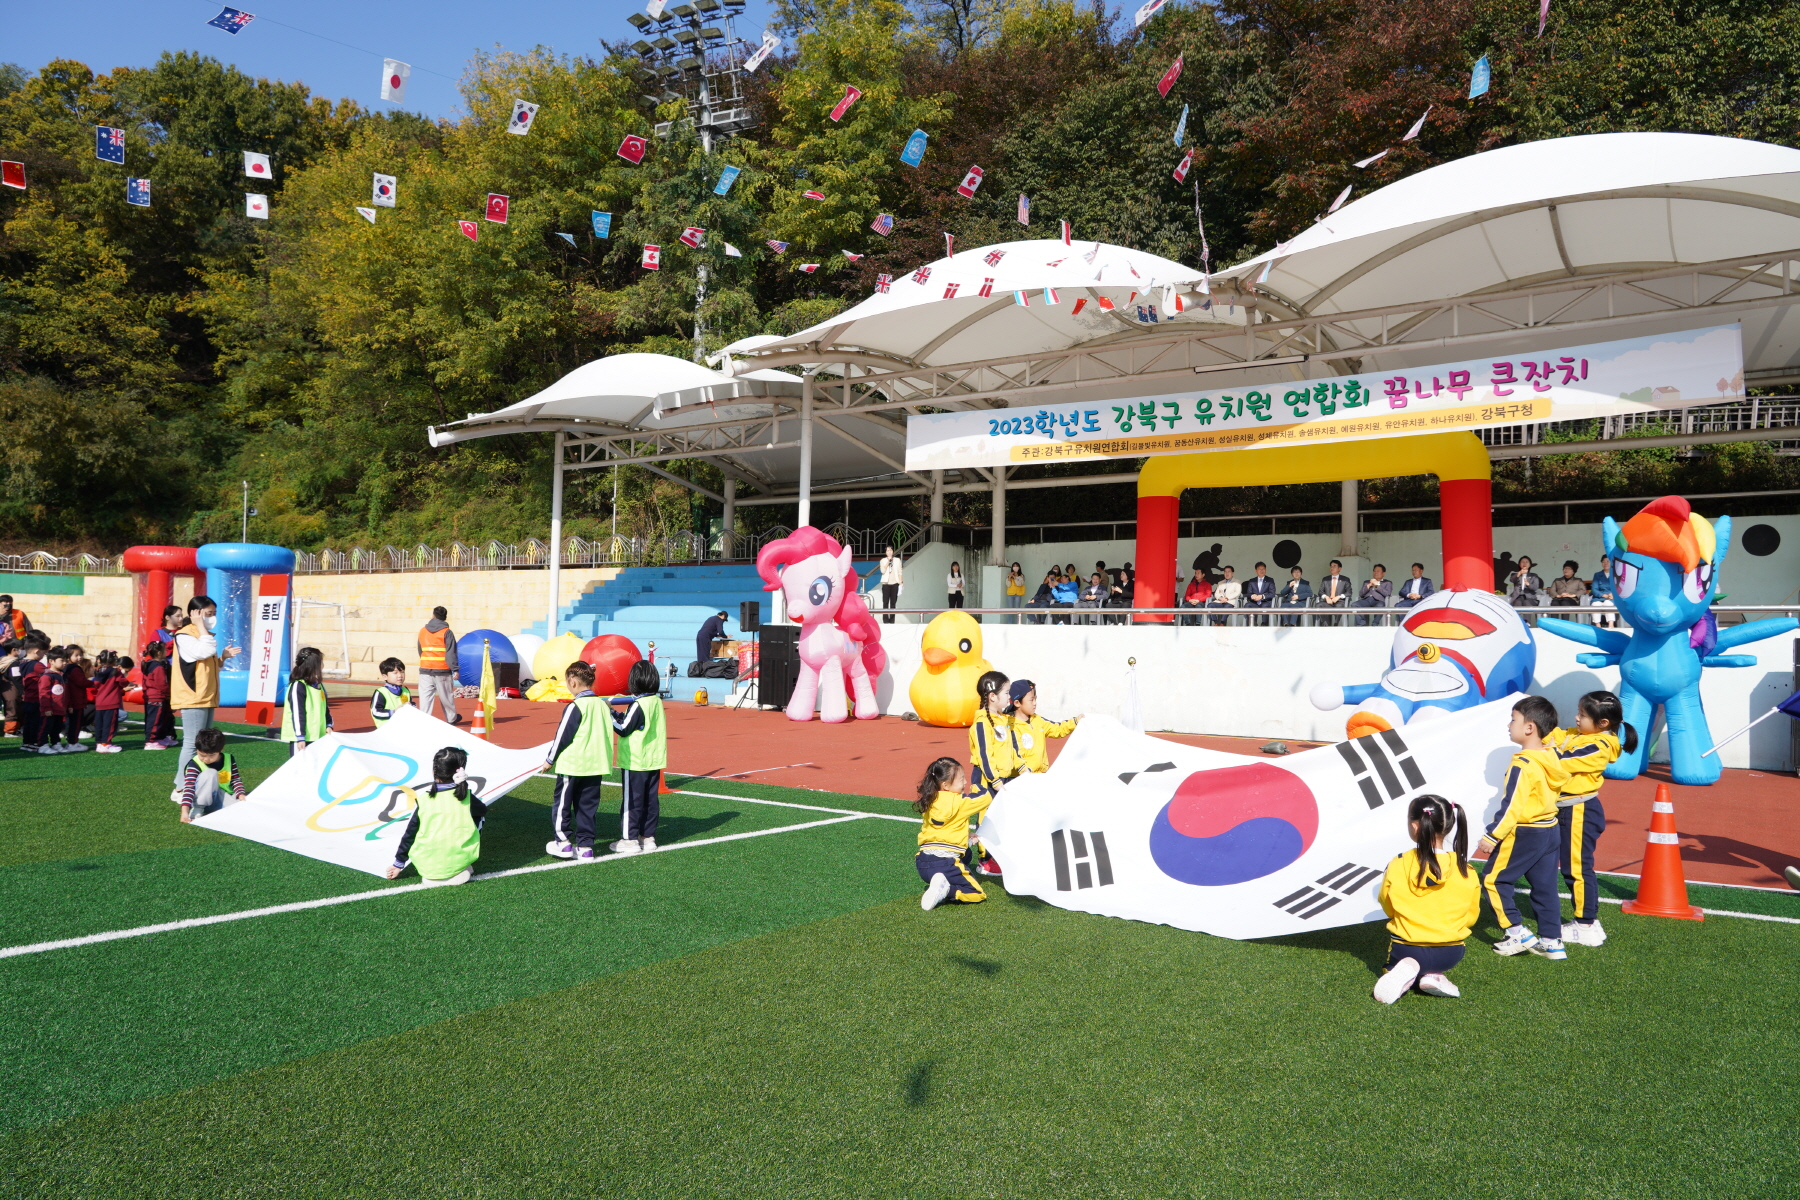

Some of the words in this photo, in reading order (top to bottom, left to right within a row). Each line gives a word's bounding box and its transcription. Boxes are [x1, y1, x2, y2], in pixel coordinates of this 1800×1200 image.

[988, 410, 1102, 439] 2023학년도
[1111, 400, 1182, 432] 강북구
[1194, 391, 1273, 425] 유치원
[1283, 379, 1370, 417] 연합회
[1383, 370, 1473, 409] 꿈나무
[1490, 357, 1588, 396] 큰잔치
[1481, 403, 1533, 420] 강북구청
[262, 603, 281, 620] 홍팀
